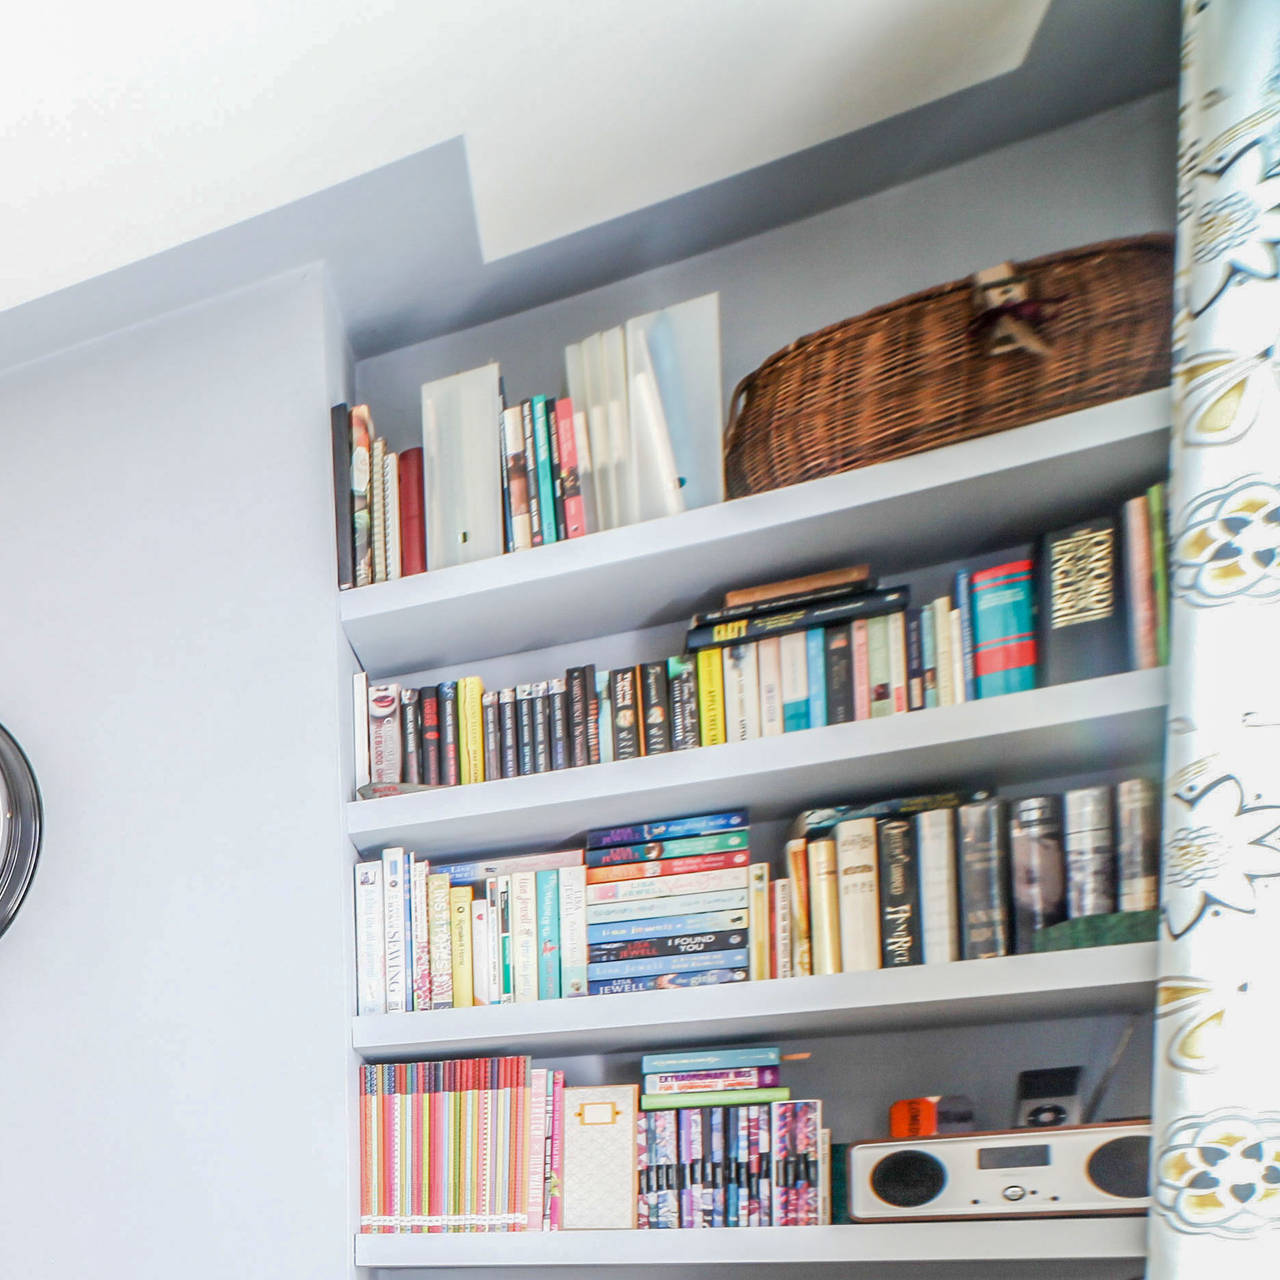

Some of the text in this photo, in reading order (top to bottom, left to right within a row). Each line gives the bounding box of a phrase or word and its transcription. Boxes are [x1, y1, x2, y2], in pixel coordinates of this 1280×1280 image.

[1088, 534, 1114, 611] OXFORD
[1051, 539, 1078, 620] ENGLISH
[674, 935, 716, 946] FOUND
[679, 943, 704, 953] YOU
[387, 930, 401, 993] SEWING
[599, 982, 647, 995] JEWELL
[612, 978, 633, 986] LISA
